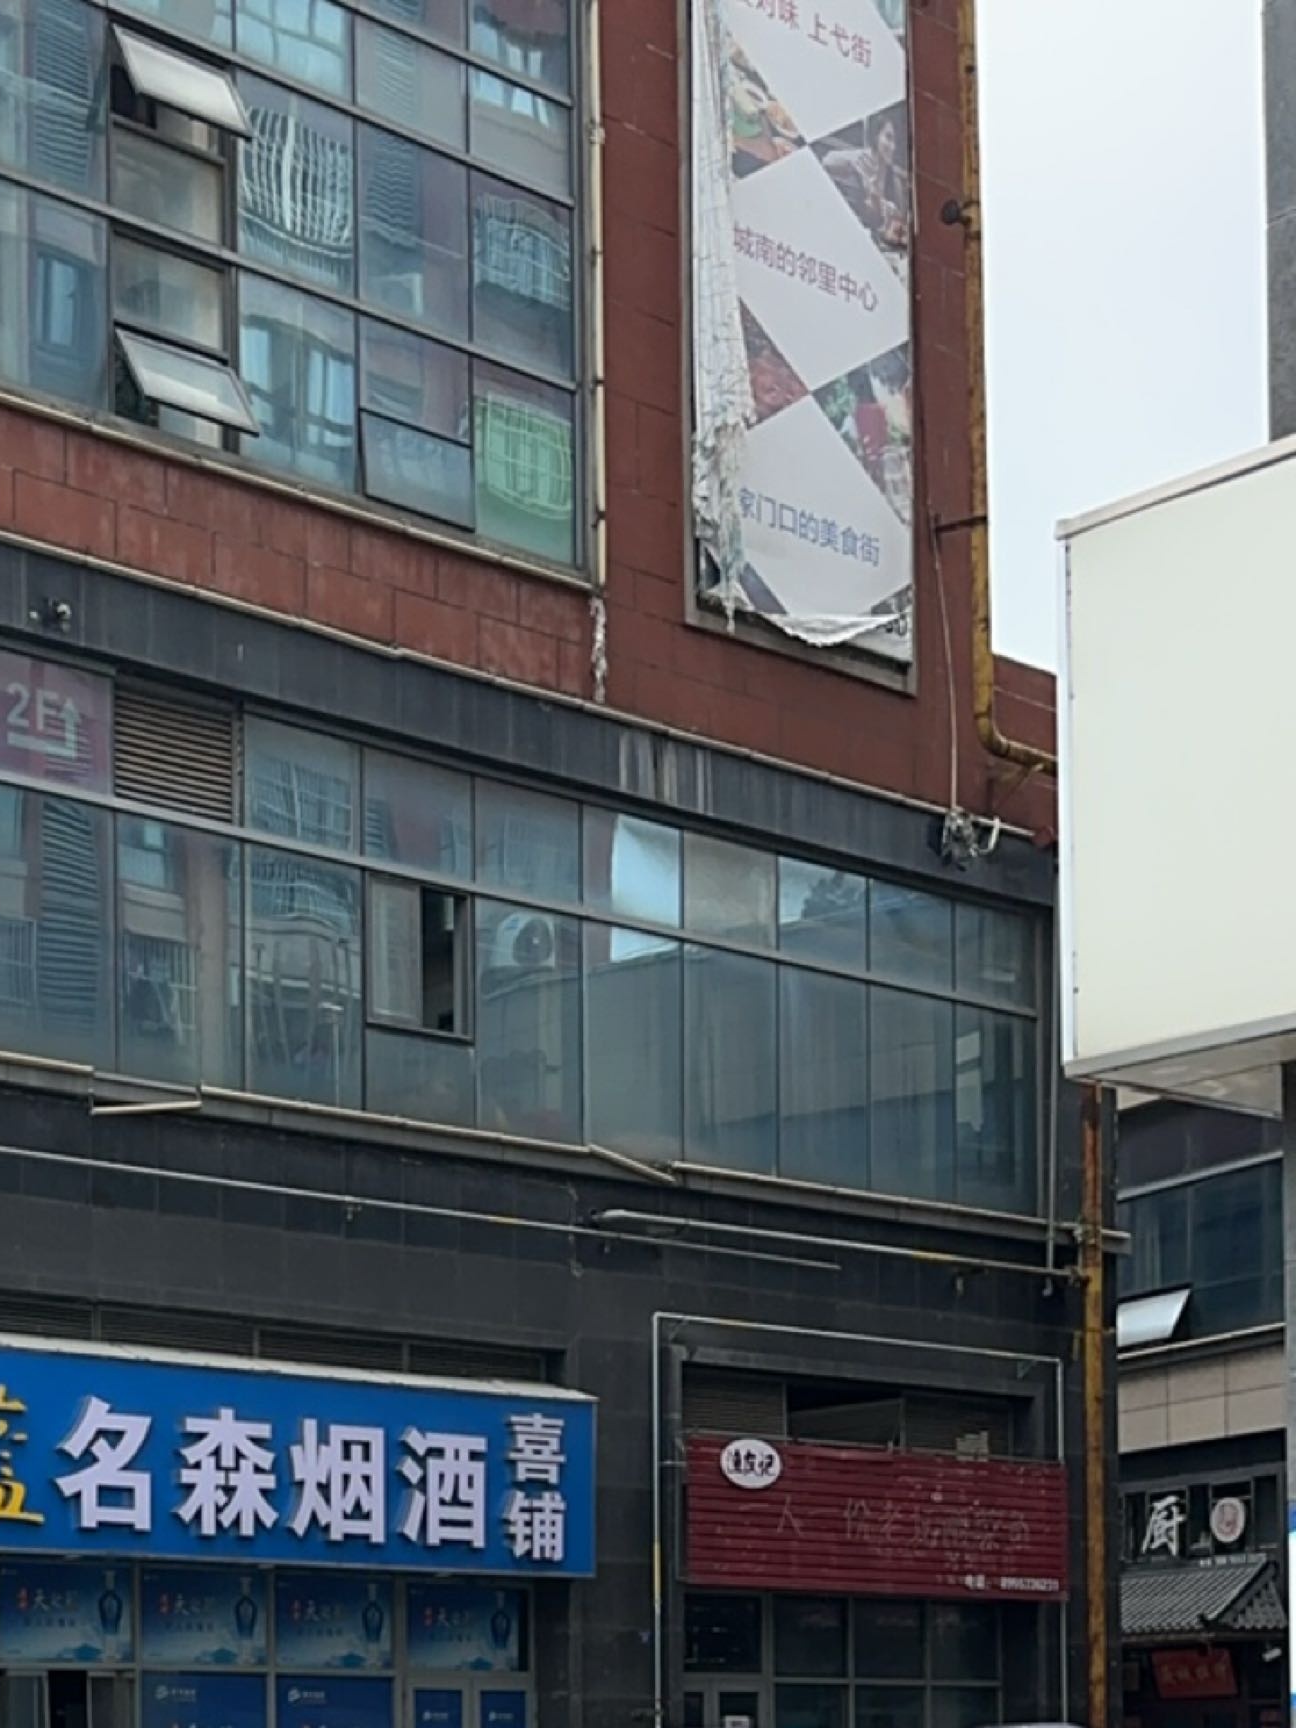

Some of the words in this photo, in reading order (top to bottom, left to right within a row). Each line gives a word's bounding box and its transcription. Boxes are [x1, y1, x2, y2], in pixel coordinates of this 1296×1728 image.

[733, 221, 879, 312] 城南的邻里中心
[739, 487, 880, 567] 家门口的美食街
[7, 682, 59, 731] 2F
[55, 1396, 488, 1548] 名森烟酒
[504, 1412, 567, 1562] 喜铺
[1142, 1496, 1186, 1556] 厨
